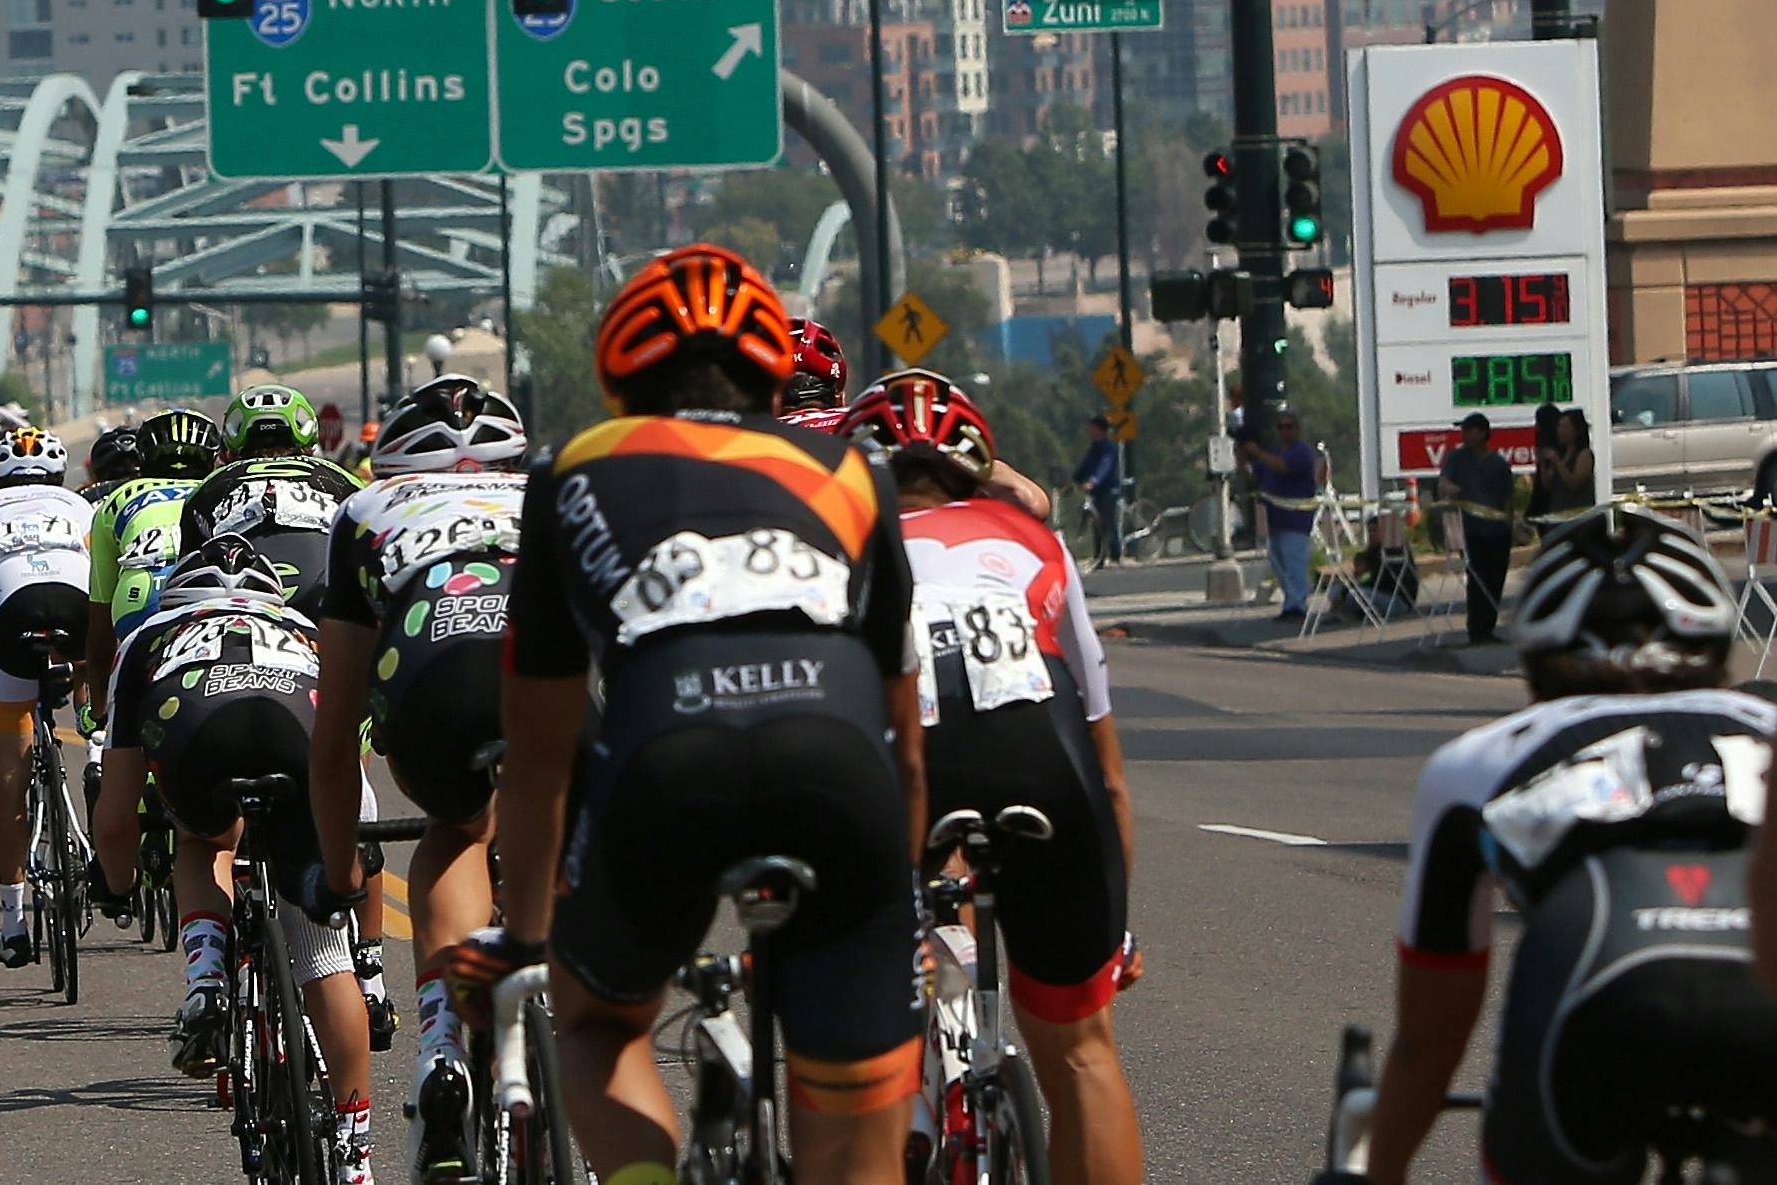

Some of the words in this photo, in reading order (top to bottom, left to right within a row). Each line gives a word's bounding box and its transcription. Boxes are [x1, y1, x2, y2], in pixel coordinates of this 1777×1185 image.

[259, 2, 302, 34] 25
[232, 71, 277, 106] Ft
[304, 70, 466, 104] Collins
[564, 59, 660, 92] Colo
[562, 112, 669, 151] Spgs
[1392, 291, 1437, 308] Regular
[1395, 371, 1432, 385] Diesel
[1453, 356, 1548, 406] 2.85
[290, 482, 329, 511] 34
[557, 474, 631, 594] OPTUM
[203, 675, 296, 697] BEANS
[711, 659, 824, 695] KELLY
[1633, 908, 1751, 931] TREK
